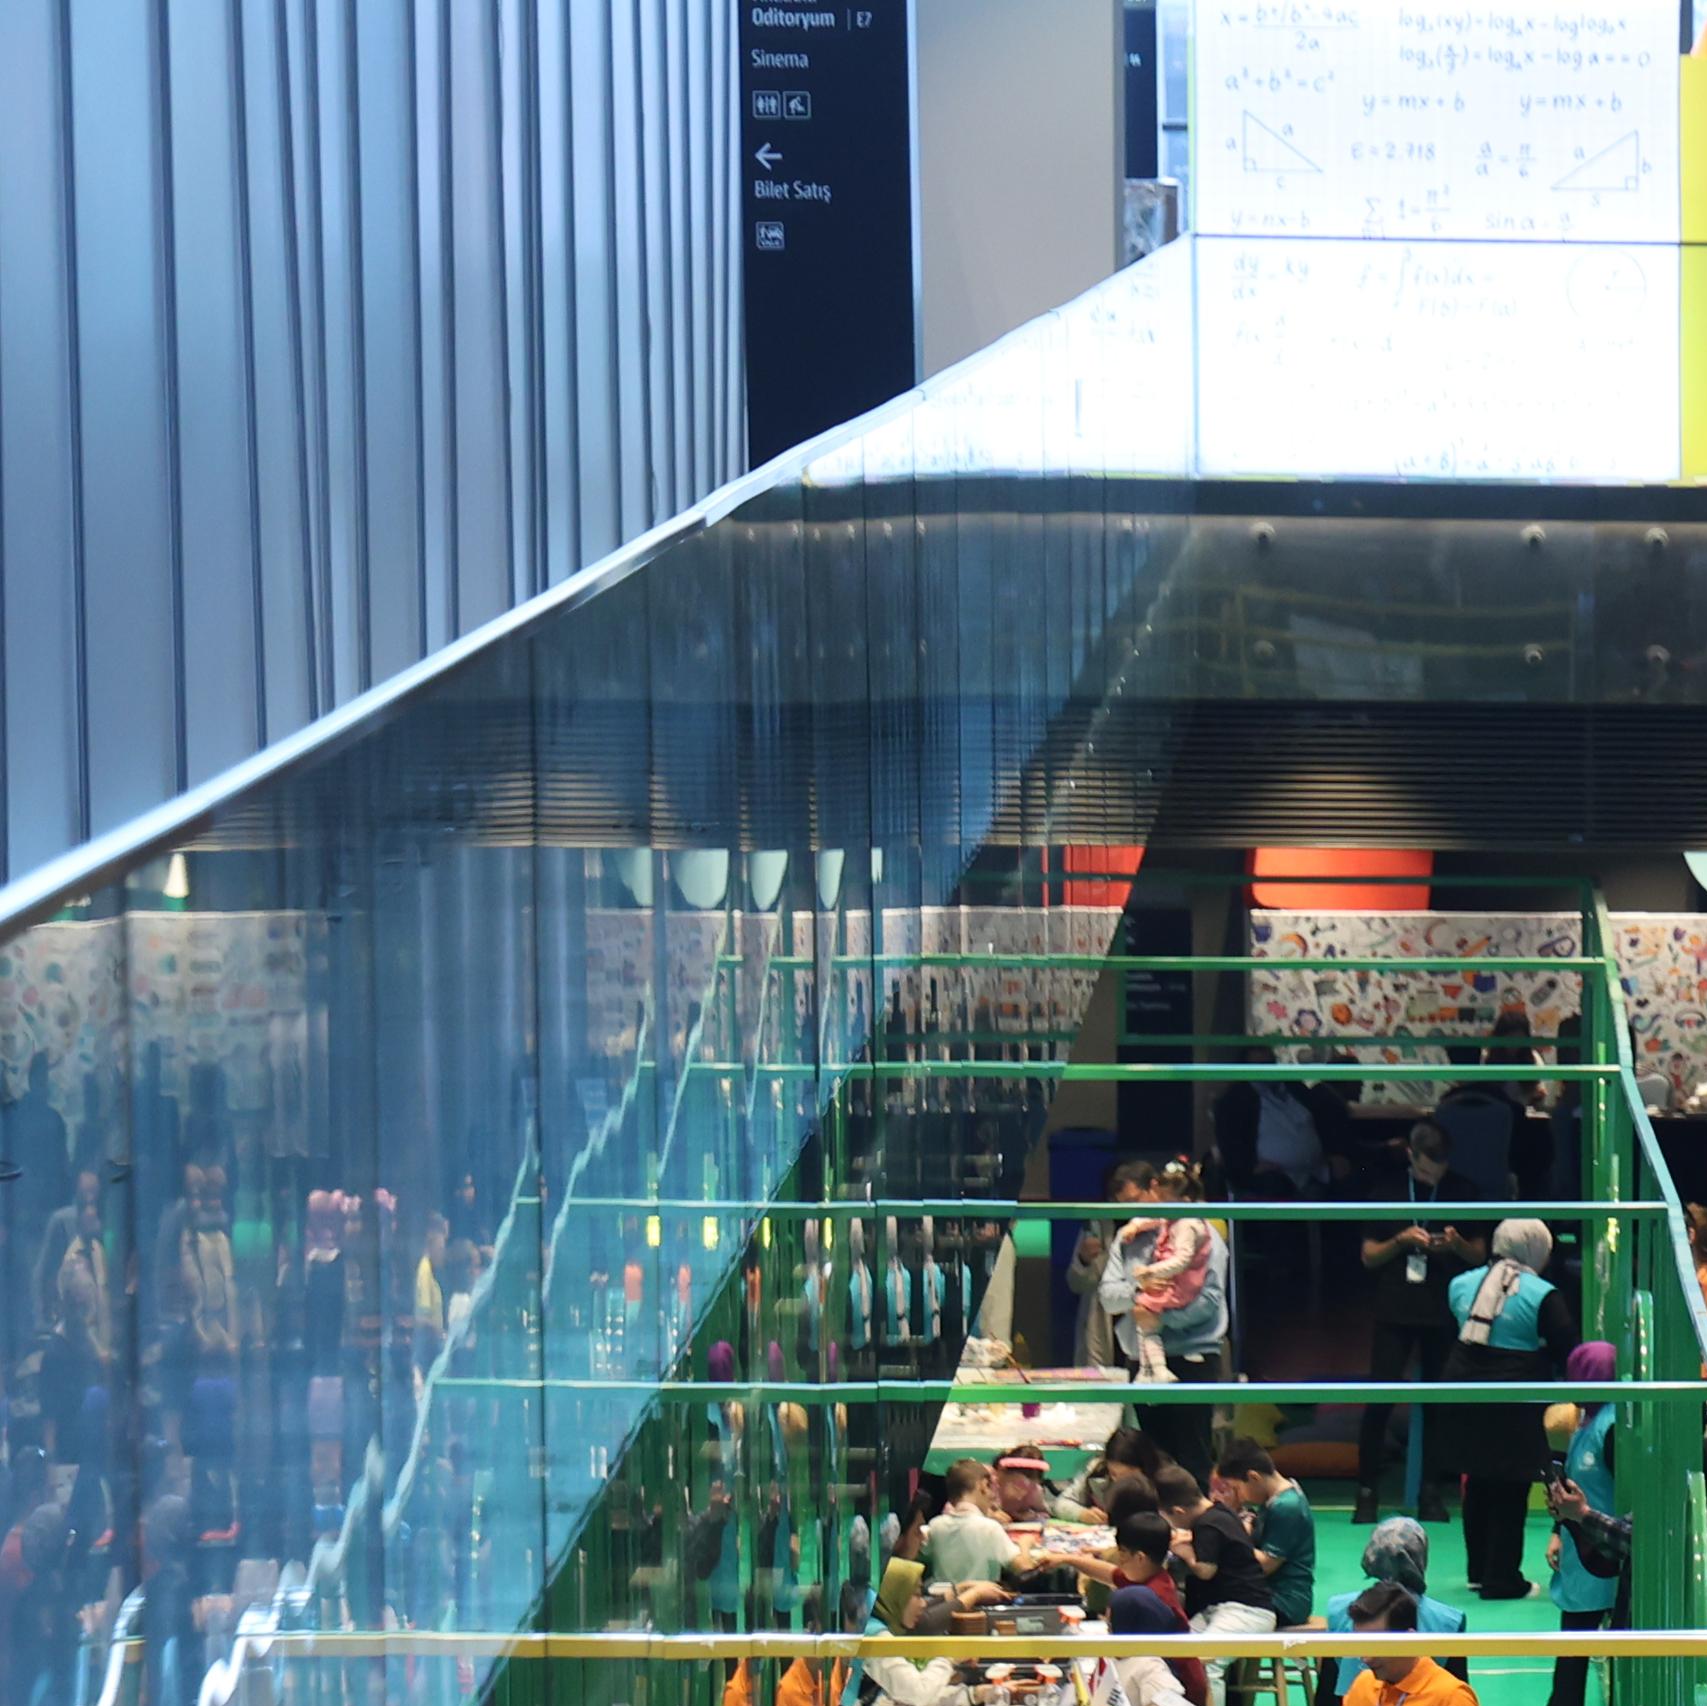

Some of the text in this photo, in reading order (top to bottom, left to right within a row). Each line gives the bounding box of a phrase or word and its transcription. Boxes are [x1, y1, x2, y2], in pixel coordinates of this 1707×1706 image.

[752, 7, 873, 31] Oditoryum E7
[751, 49, 810, 69] Sinema
[754, 180, 833, 203] Bilet Satış
